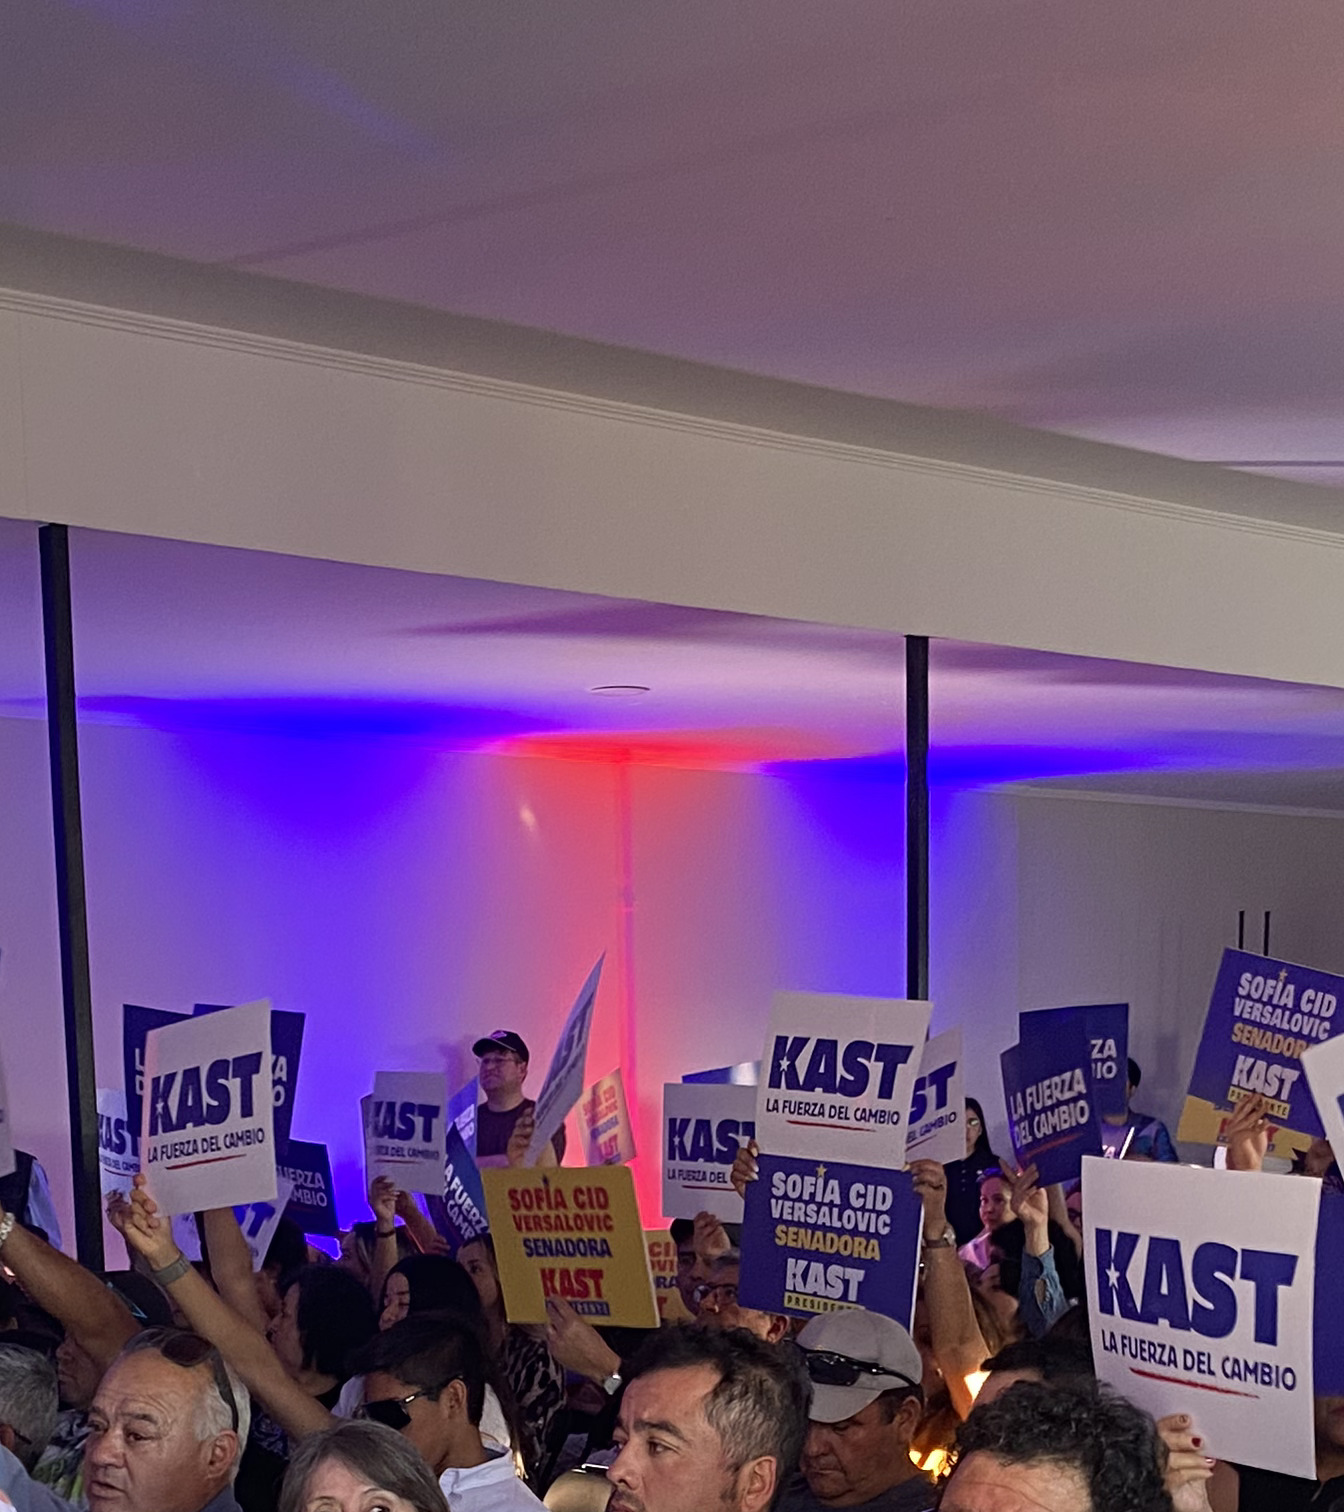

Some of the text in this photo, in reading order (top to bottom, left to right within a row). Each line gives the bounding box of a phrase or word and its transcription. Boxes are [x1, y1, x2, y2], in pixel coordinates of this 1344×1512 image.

[1234, 997, 1330, 1040] VERSALOVIC
[1300, 989, 1336, 1018] CID
[1232, 1022, 1310, 1059] SENADOR
[768, 1035, 914, 1100] KAST
[1231, 1055, 1301, 1100] KAST
[149, 1051, 264, 1137] KAST
[766, 1099, 900, 1126] LA FUERZA DEL CAMBIO
[908, 1061, 957, 1126] ST
[1010, 1092, 1025, 1120] LA
[1026, 1068, 1087, 1114] FUERZA
[1014, 1100, 1090, 1149] DEL CAMBIO
[148, 1127, 265, 1164] LA FUERZA DEL CAMBIO
[289, 1189, 328, 1207] MBIO
[450, 1176, 490, 1234] FUERZ
[573, 1187, 609, 1210] CID
[849, 1183, 894, 1212] CID
[446, 1200, 475, 1240] CAMB
[512, 1214, 613, 1233] VERSALOVIC
[770, 1198, 891, 1236] VERSALOVIC
[523, 1237, 612, 1258] SENADORA
[775, 1224, 881, 1261] SENADORA
[540, 1268, 603, 1299] KAST
[786, 1258, 865, 1302] KAST
[1095, 1227, 1299, 1346] KAST
[787, 1295, 856, 1312] PRESIDE
[1101, 1329, 1297, 1391] LA FUERZA DEL CAMBIO
